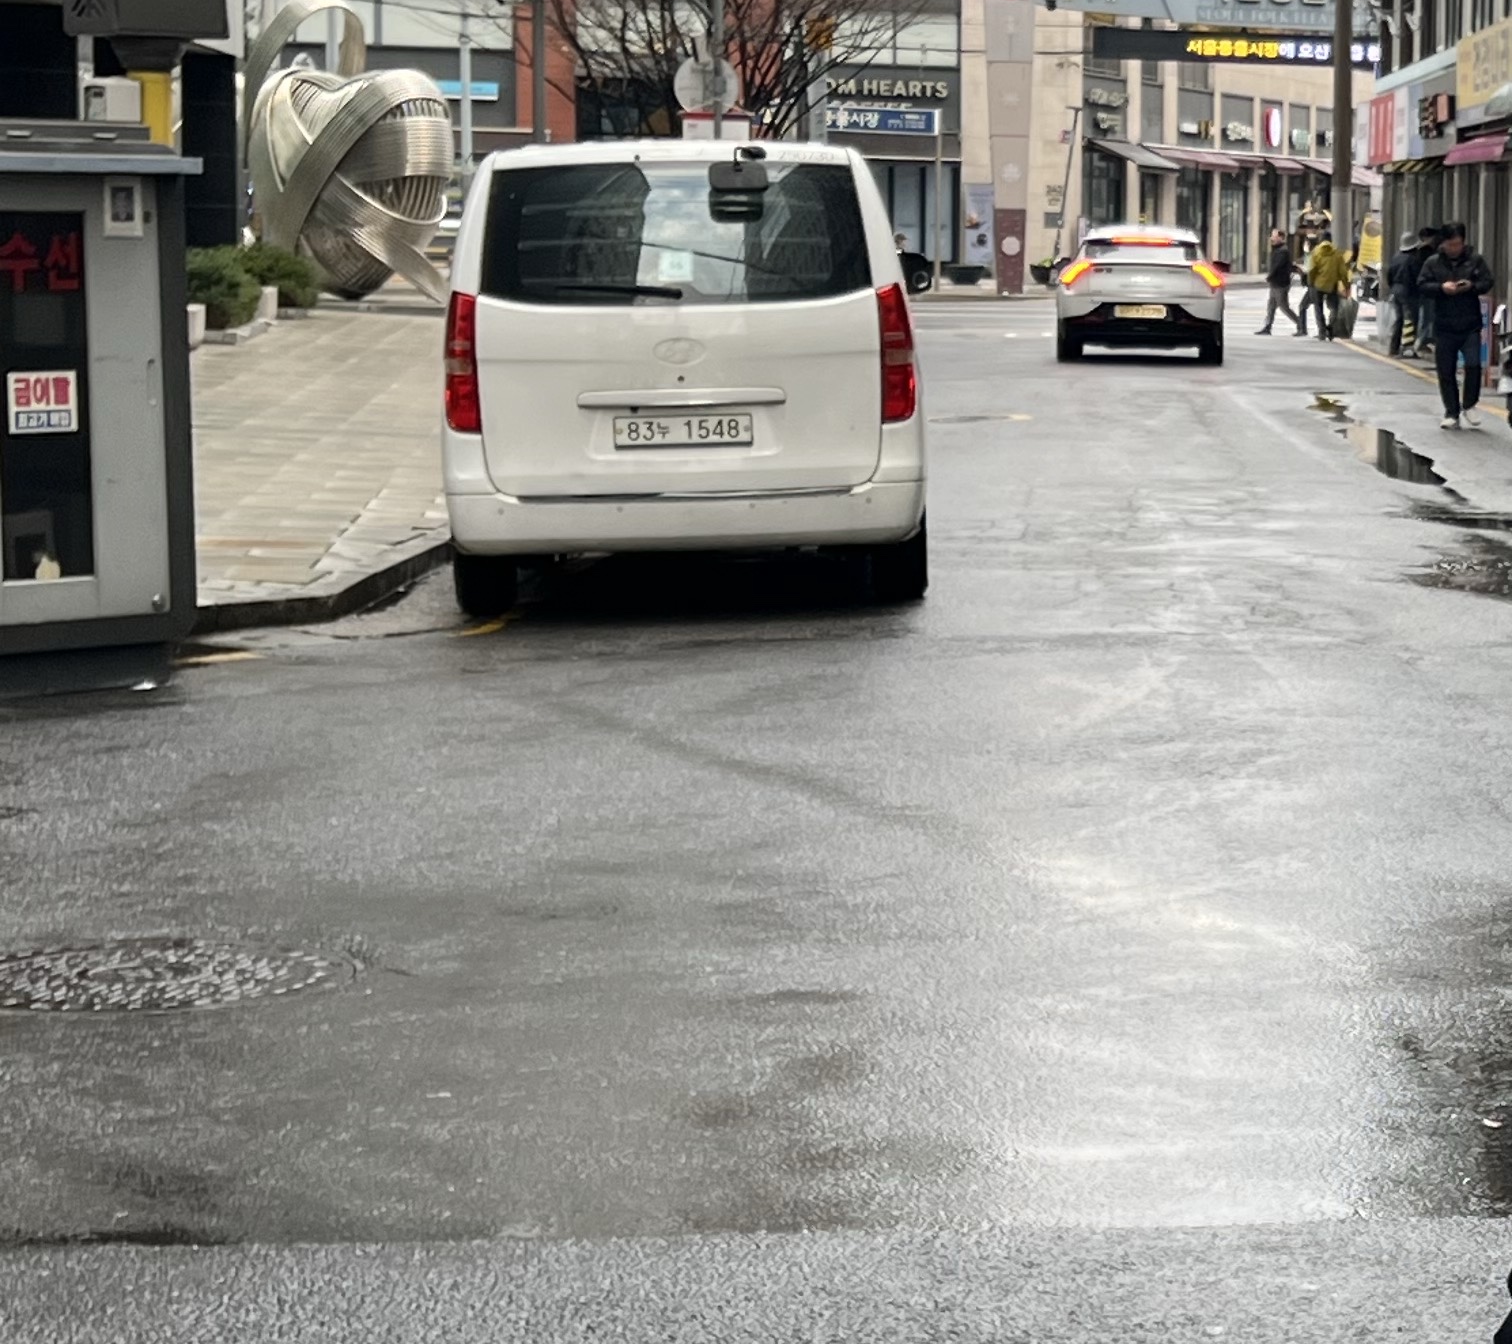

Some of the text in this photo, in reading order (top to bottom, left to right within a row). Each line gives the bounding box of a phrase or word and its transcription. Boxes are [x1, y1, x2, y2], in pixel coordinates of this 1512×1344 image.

[863, 79, 949, 99] HEARTS
[0, 231, 80, 294] 수선
[627, 418, 740, 442] 83누 1548
